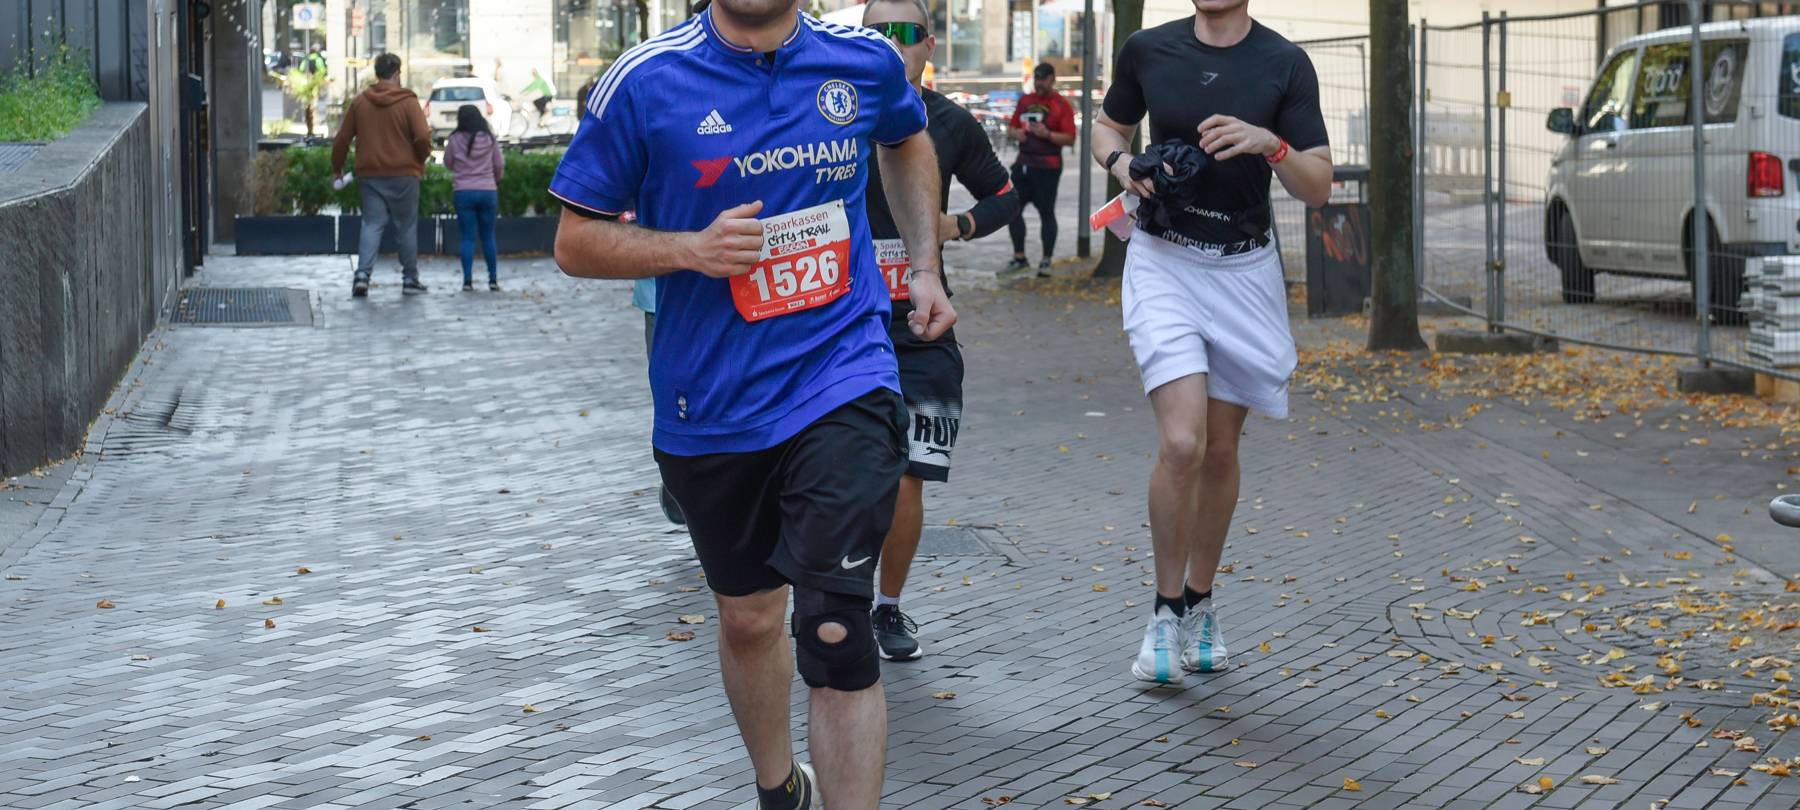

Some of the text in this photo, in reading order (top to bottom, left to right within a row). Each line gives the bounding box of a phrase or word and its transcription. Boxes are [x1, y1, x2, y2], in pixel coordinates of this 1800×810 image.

[696, 122, 732, 135] adidas
[733, 137, 859, 178] YOKOHAMA
[815, 162, 857, 185] TYRES
[765, 210, 829, 234] Sparkassen
[749, 249, 839, 302] 1526
[883, 266, 913, 290] 14
[913, 413, 960, 448] RUN
